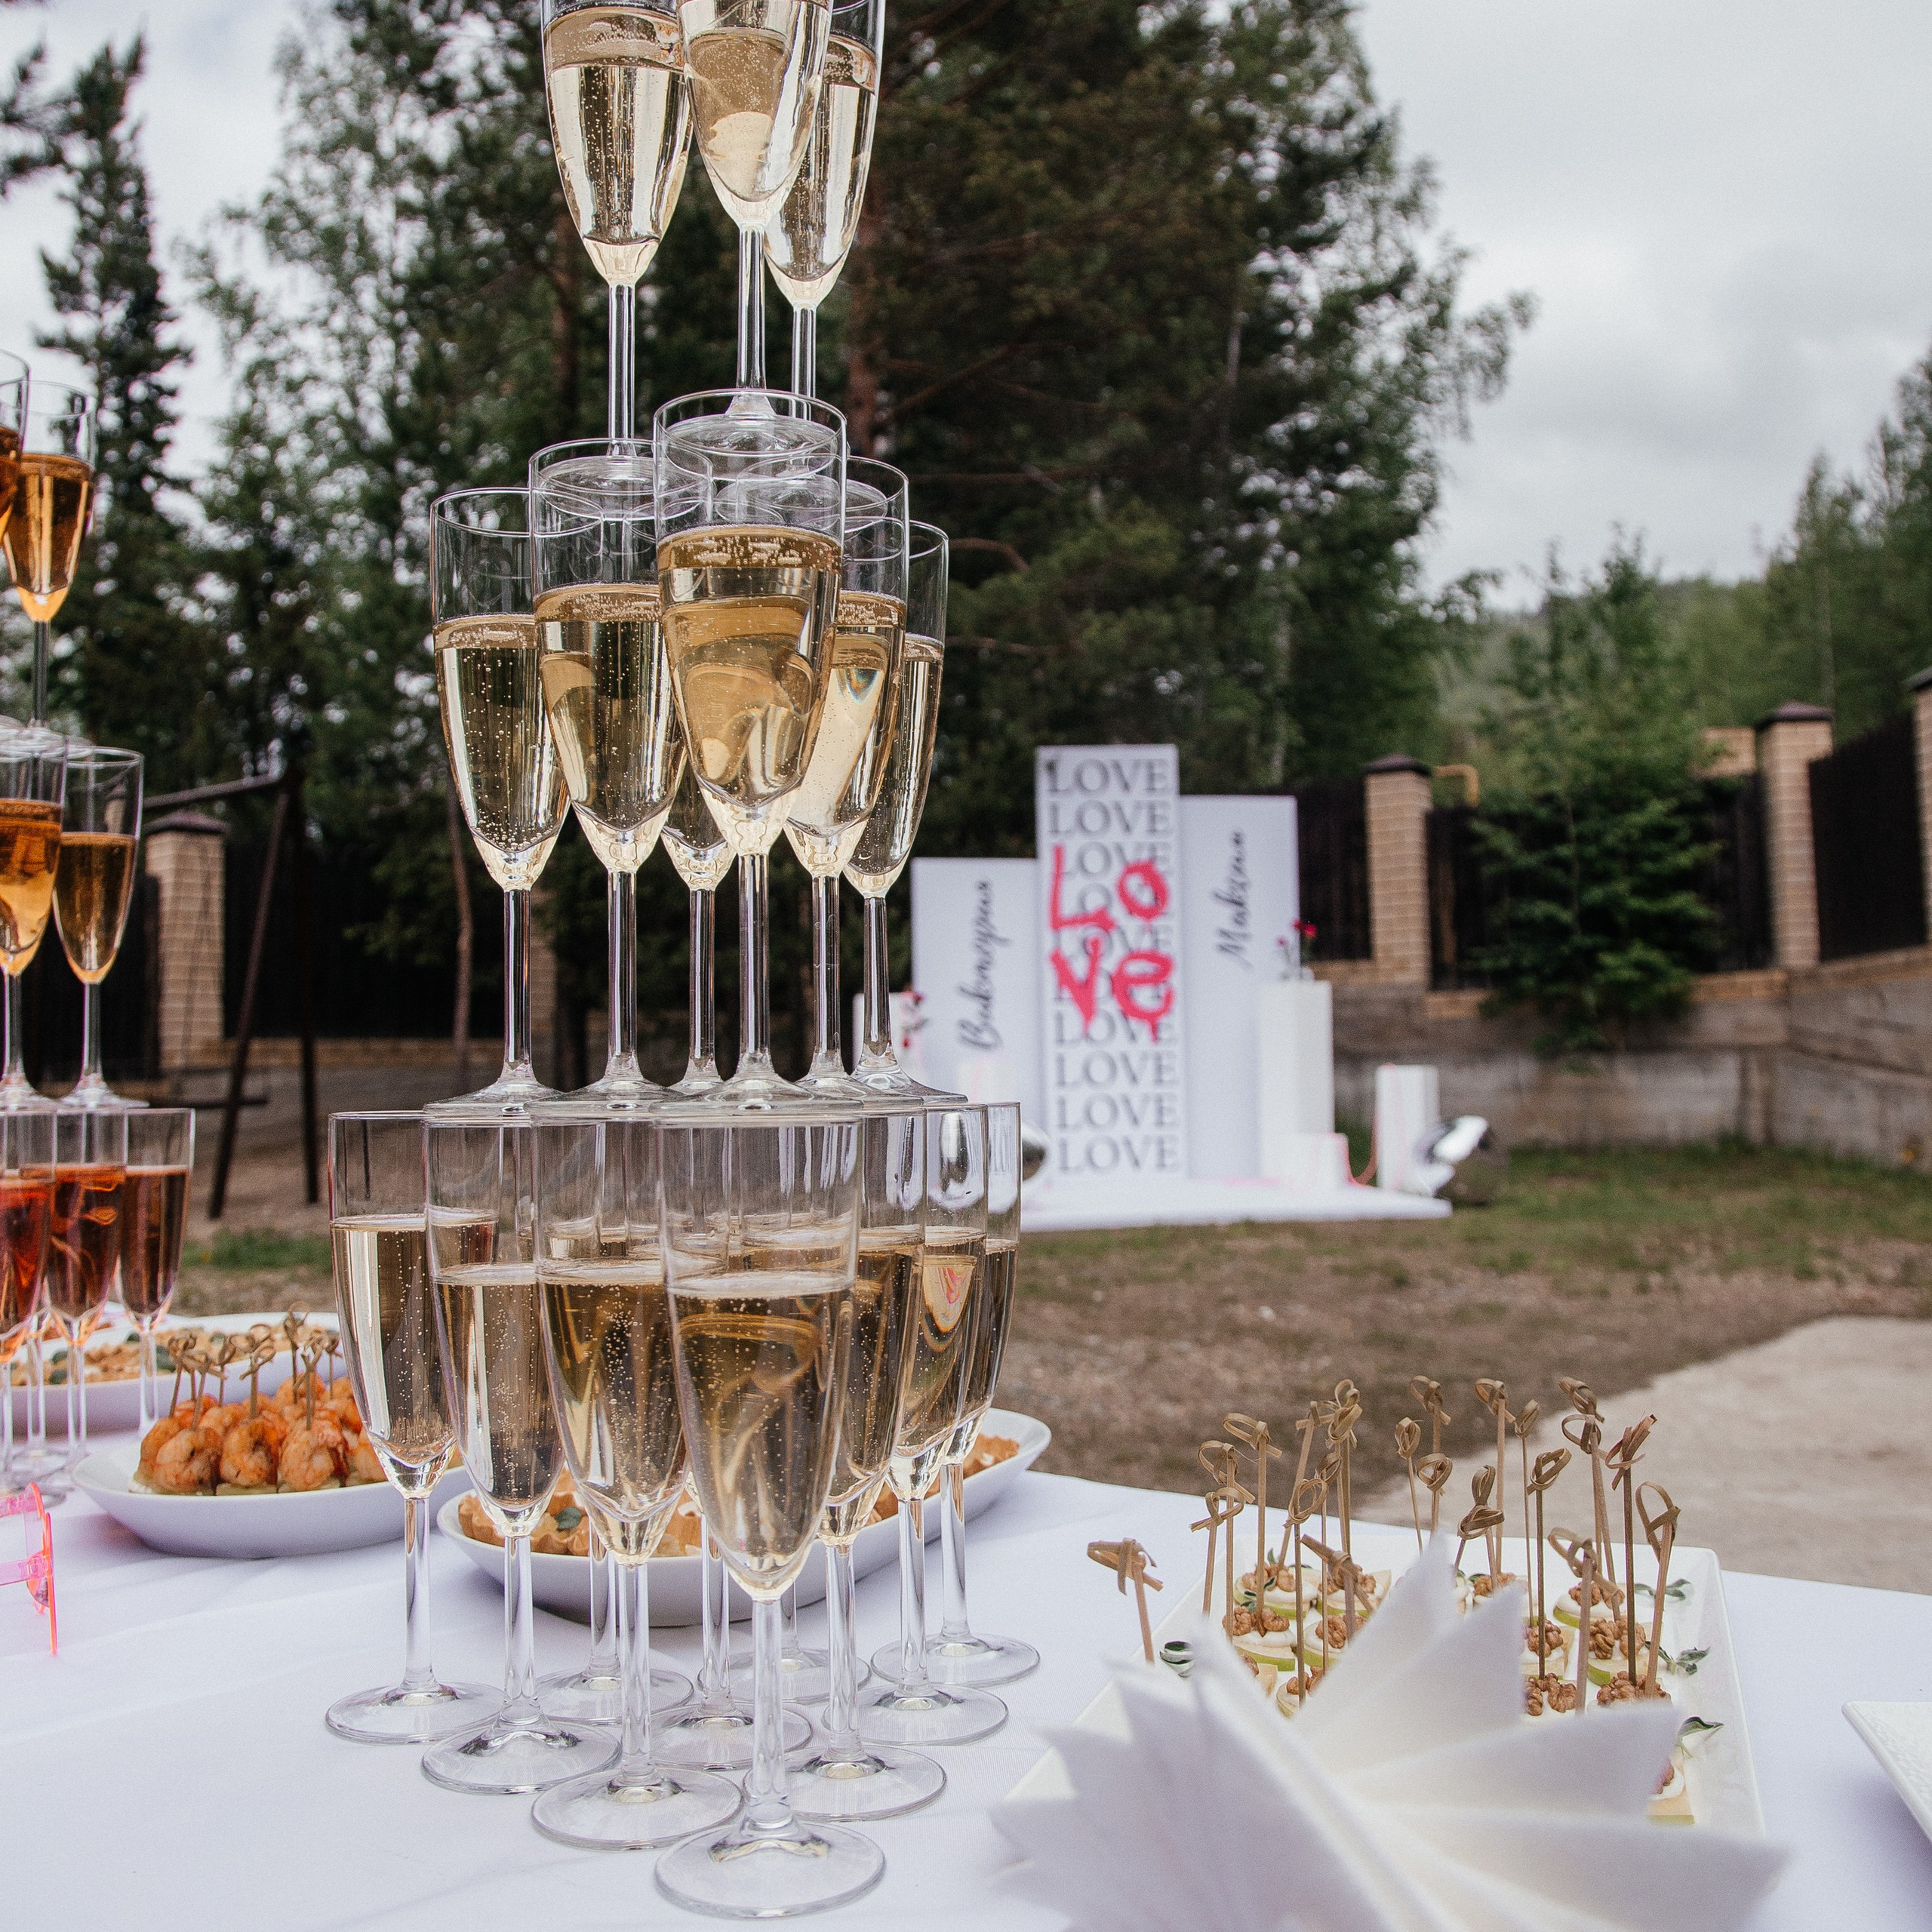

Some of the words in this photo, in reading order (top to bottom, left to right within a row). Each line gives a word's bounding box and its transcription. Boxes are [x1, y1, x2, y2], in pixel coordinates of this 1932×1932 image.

[1048, 758, 1168, 792] LOVE
[1050, 800, 1170, 835] LOVE
[1055, 1051, 1177, 1086] LOVE
[1057, 1093, 1178, 1128] LOVE
[1058, 1134, 1179, 1171] LOVE
